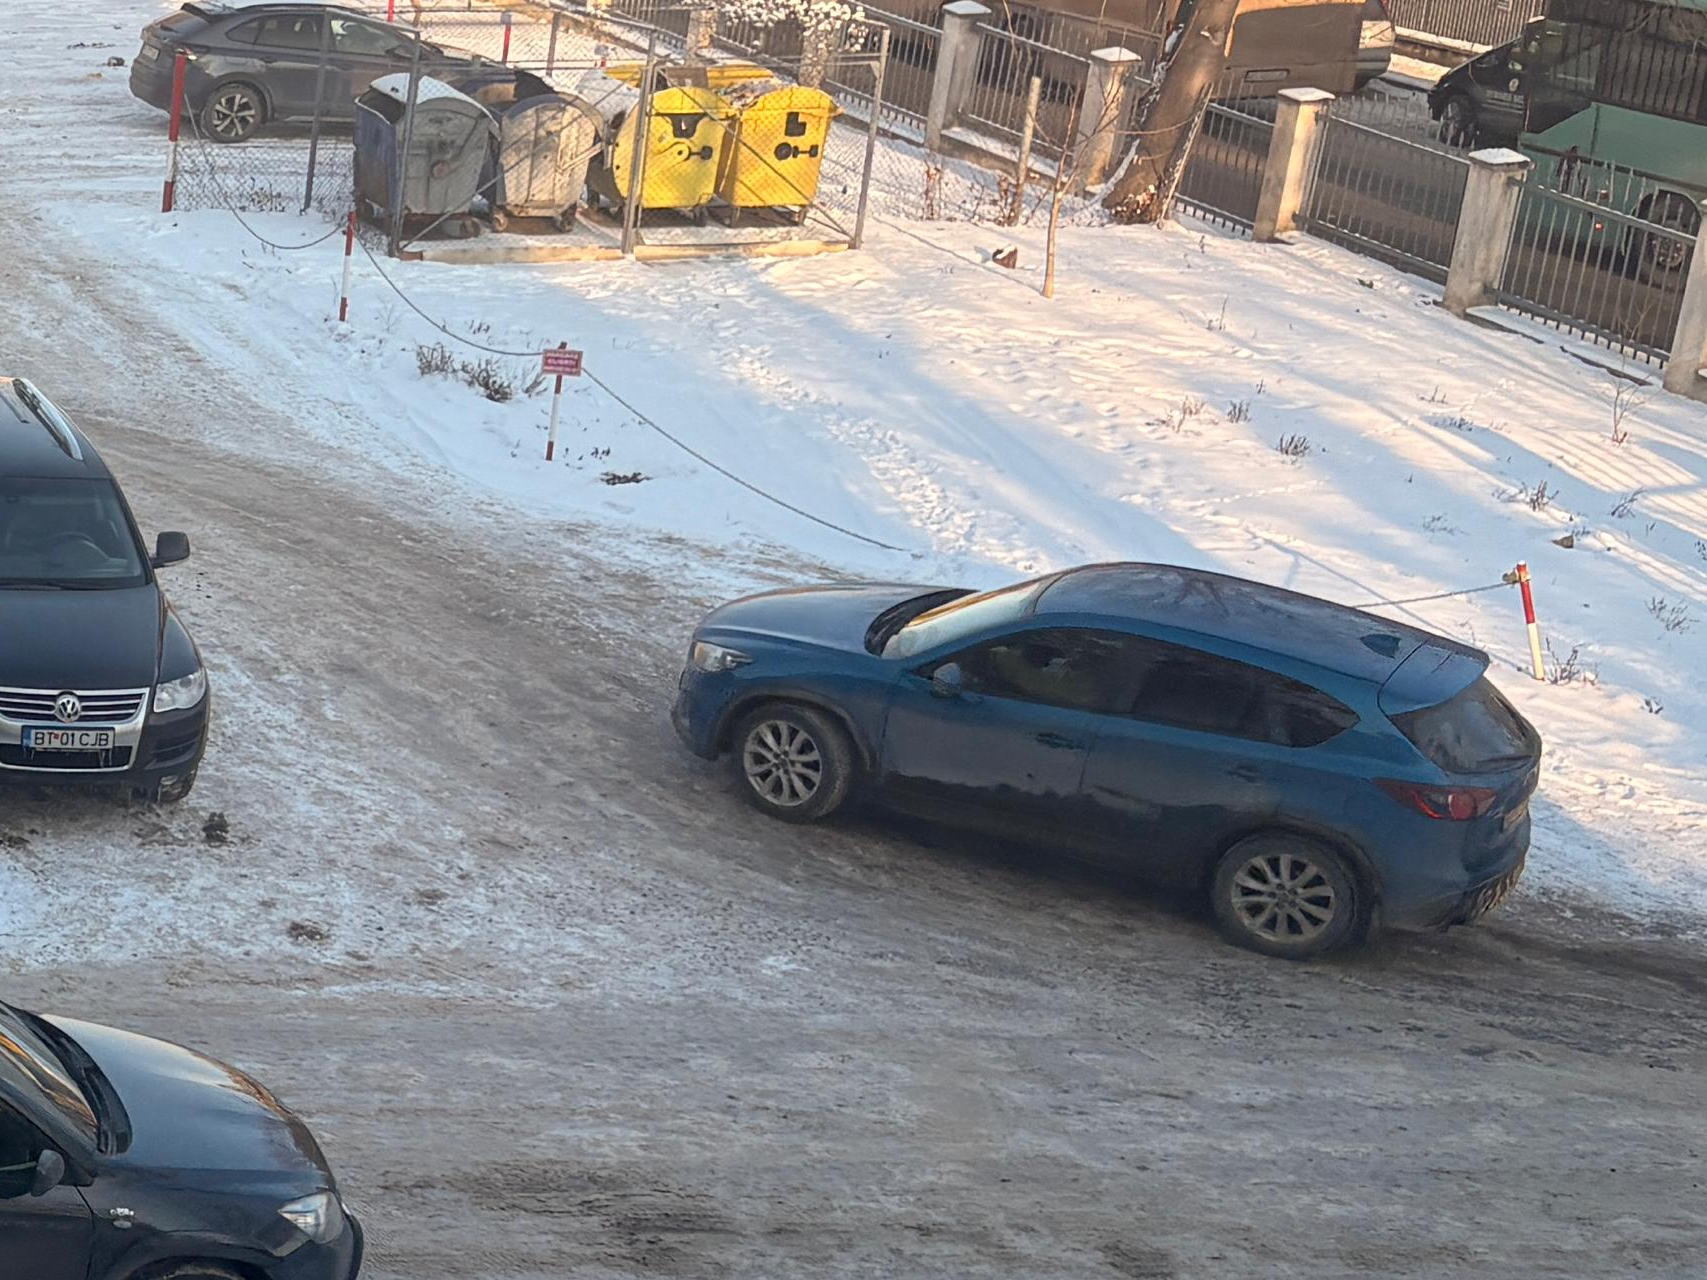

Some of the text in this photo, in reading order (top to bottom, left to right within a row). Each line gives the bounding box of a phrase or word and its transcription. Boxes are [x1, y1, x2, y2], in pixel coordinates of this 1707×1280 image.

[34, 731, 110, 747] BT 01 CJB
